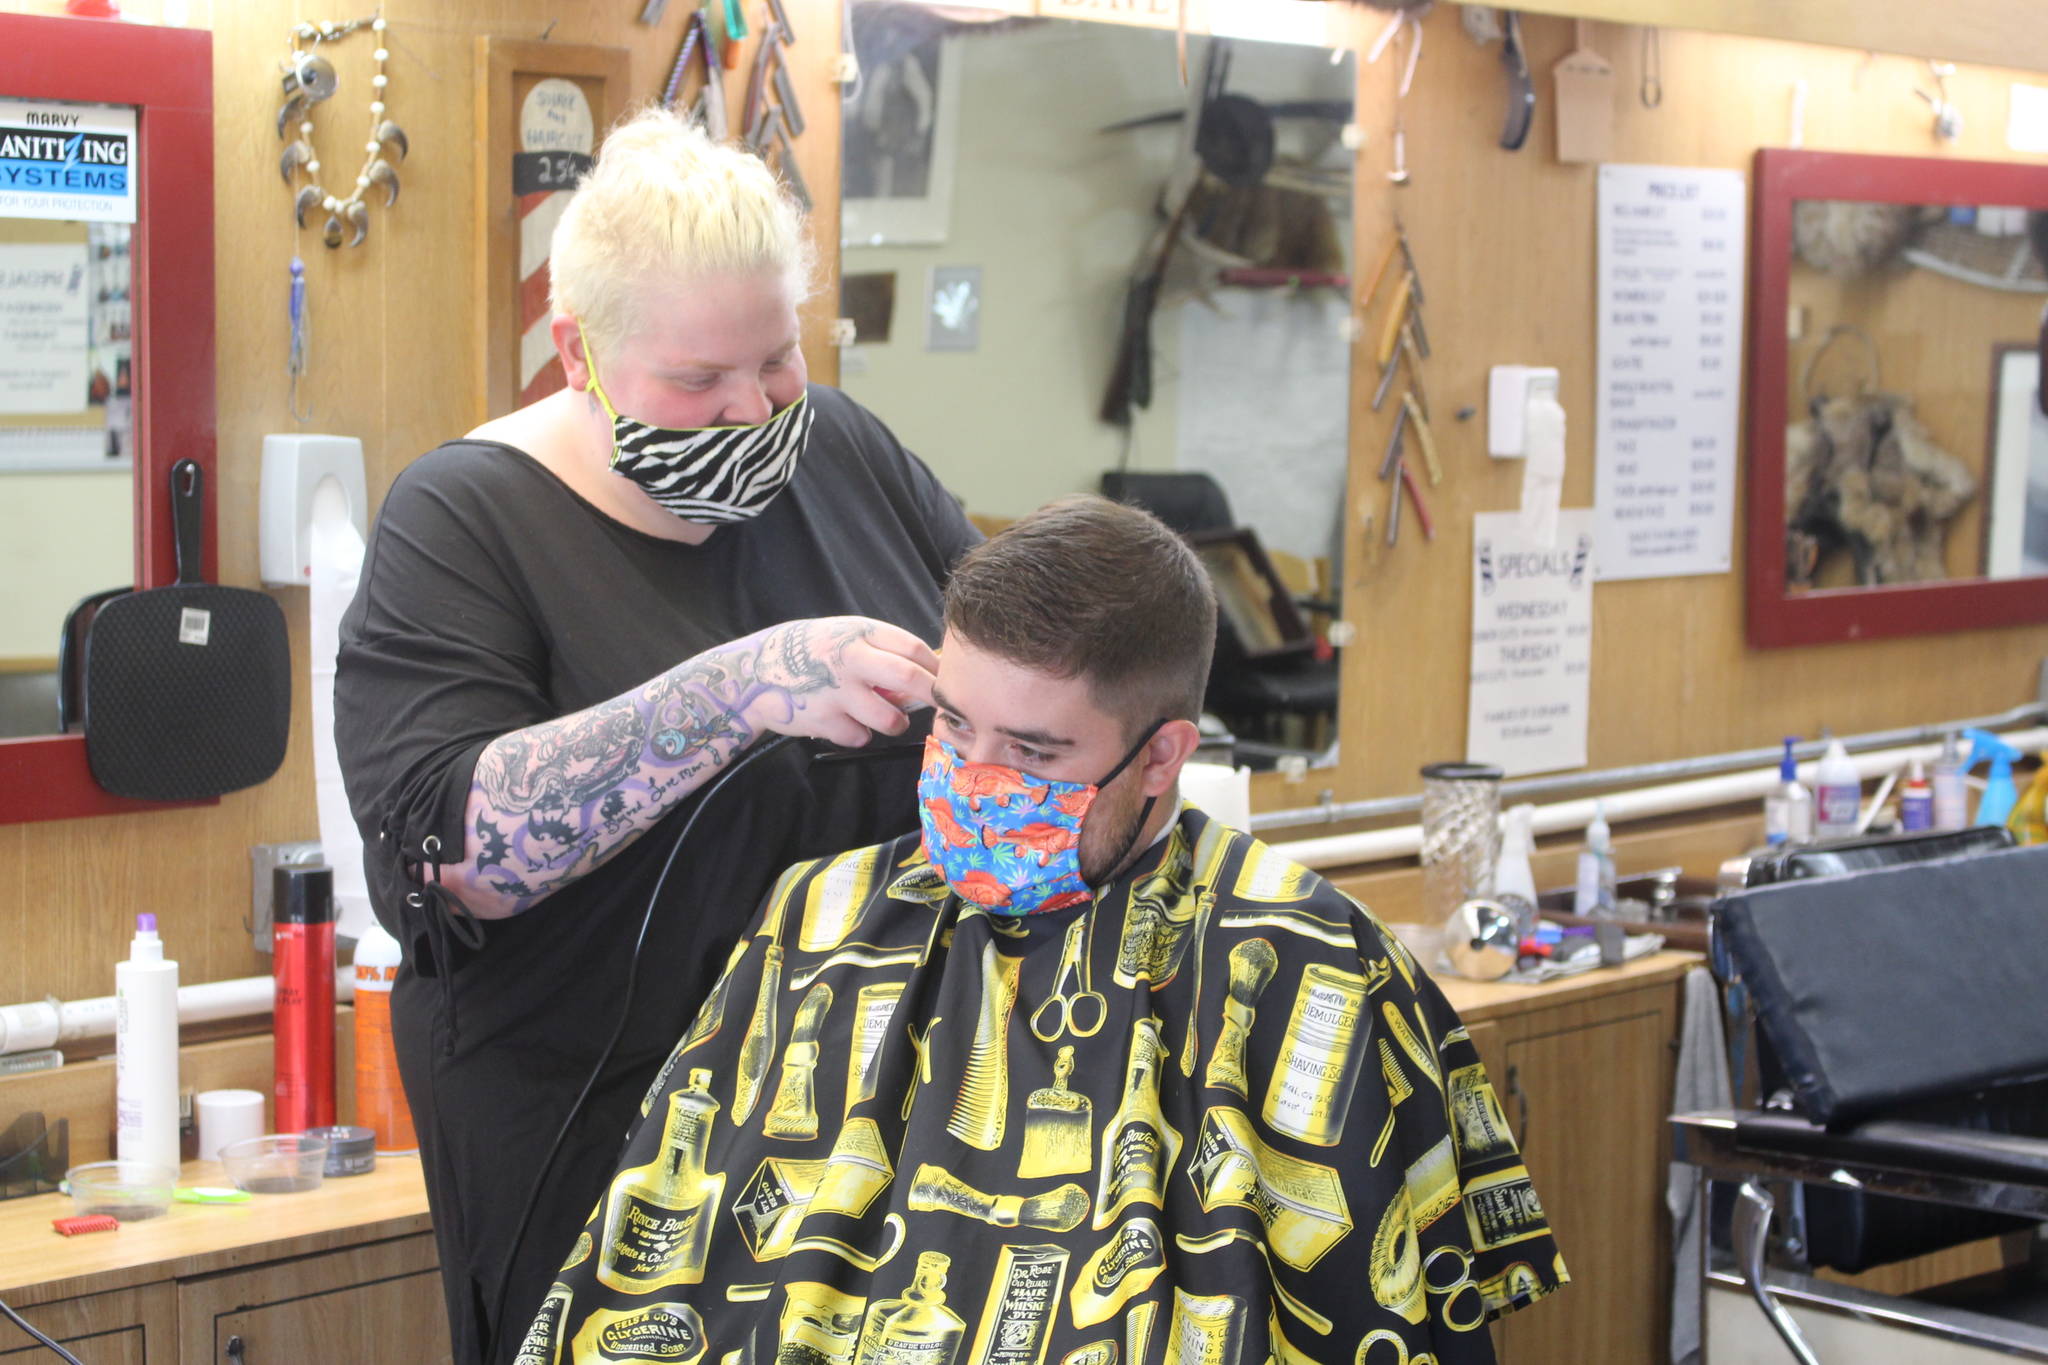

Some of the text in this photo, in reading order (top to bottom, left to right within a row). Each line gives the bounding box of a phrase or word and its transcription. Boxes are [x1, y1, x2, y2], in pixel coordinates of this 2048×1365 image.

[26, 111, 80, 127] MARVY
[0, 132, 127, 165] ANITIZING
[0, 165, 127, 191] YSTEMS
[1498, 551, 1570, 579] SPECIALS
[1303, 1001, 1357, 1028] DEMULCEN
[1281, 1049, 1326, 1077] SHAVING
[1011, 1288, 1048, 1298] HAIR
[614, 1315, 640, 1331] FELS
[640, 1312, 650, 1323] &
[1008, 1311, 1042, 1320] DYE
